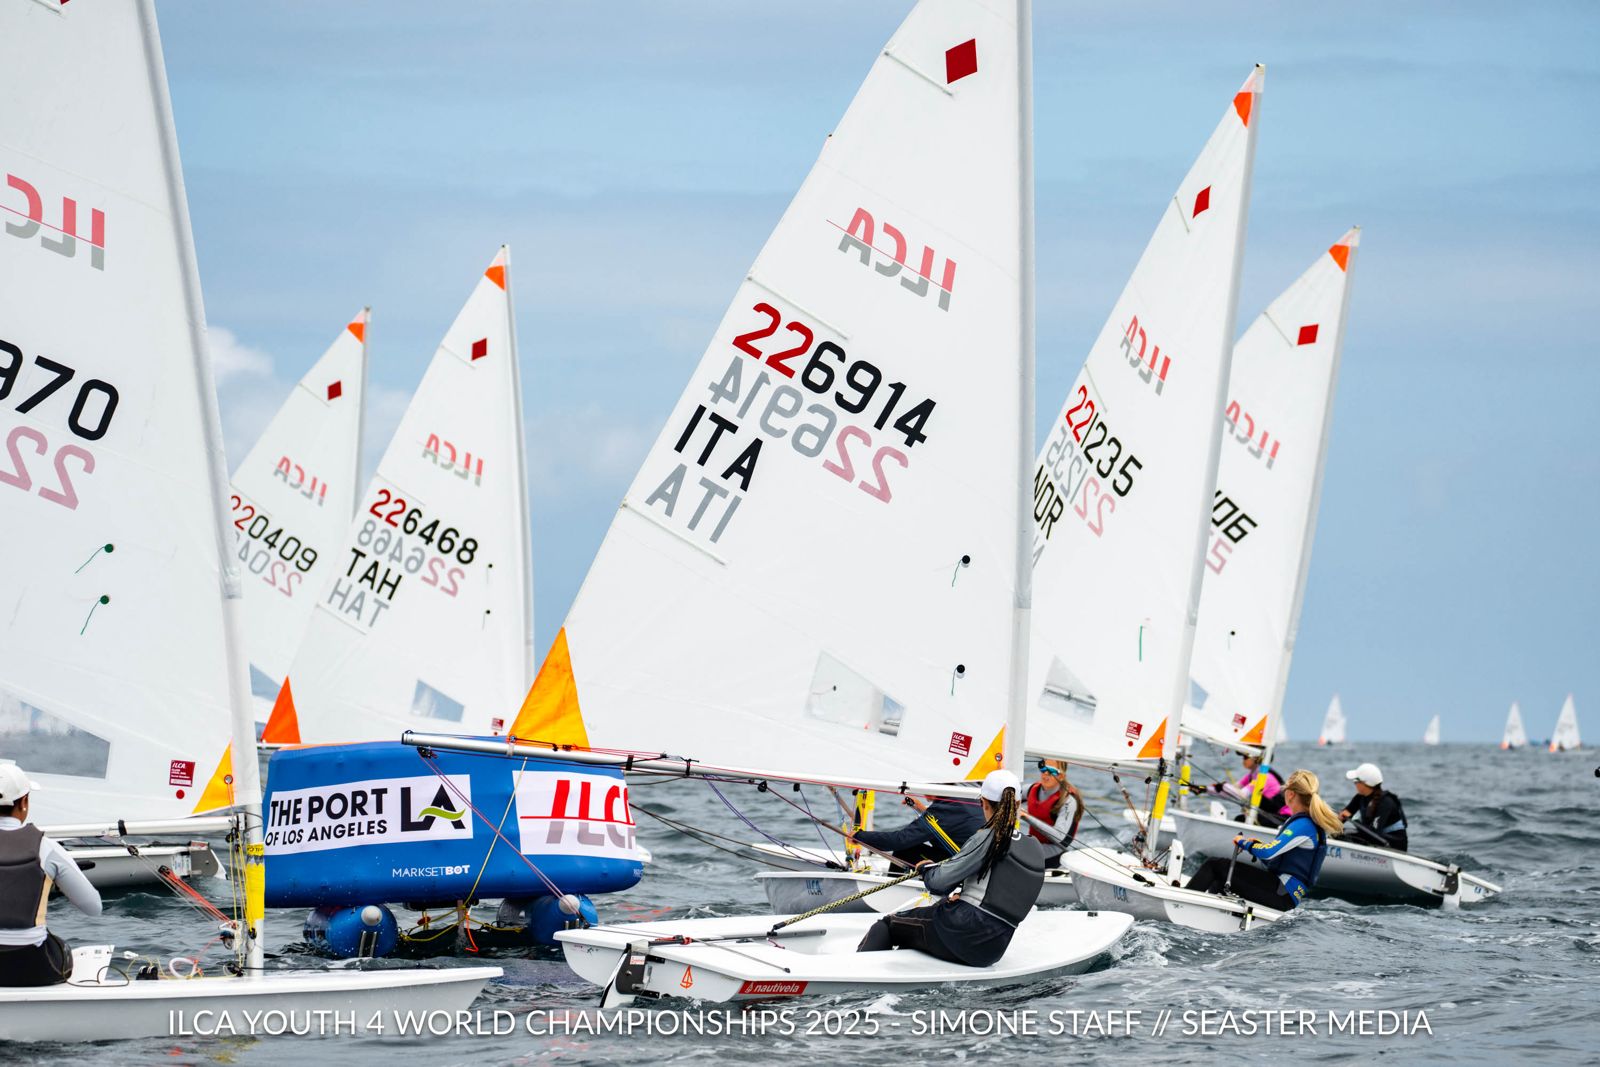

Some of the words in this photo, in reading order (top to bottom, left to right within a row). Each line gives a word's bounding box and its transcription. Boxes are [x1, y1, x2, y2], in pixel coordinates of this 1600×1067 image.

[732, 302, 937, 448] 226914
[674, 403, 764, 492] ITA
[1065, 384, 1143, 497] 221235
[369, 488, 478, 565] 226468
[1034, 464, 1064, 540] NOR
[1211, 489, 1258, 544] 06
[231, 495, 318, 573] 220409
[344, 547, 403, 601] TAH
[265, 831, 279, 846] OF
[282, 830, 303, 846] LOS
[307, 819, 388, 842] ANGELES
[271, 798, 302, 827] THE
[308, 788, 388, 822] PORT
[400, 784, 466, 832] LA
[392, 864, 470, 878] MARKSETBOT
[754, 982, 800, 992] nautivela
